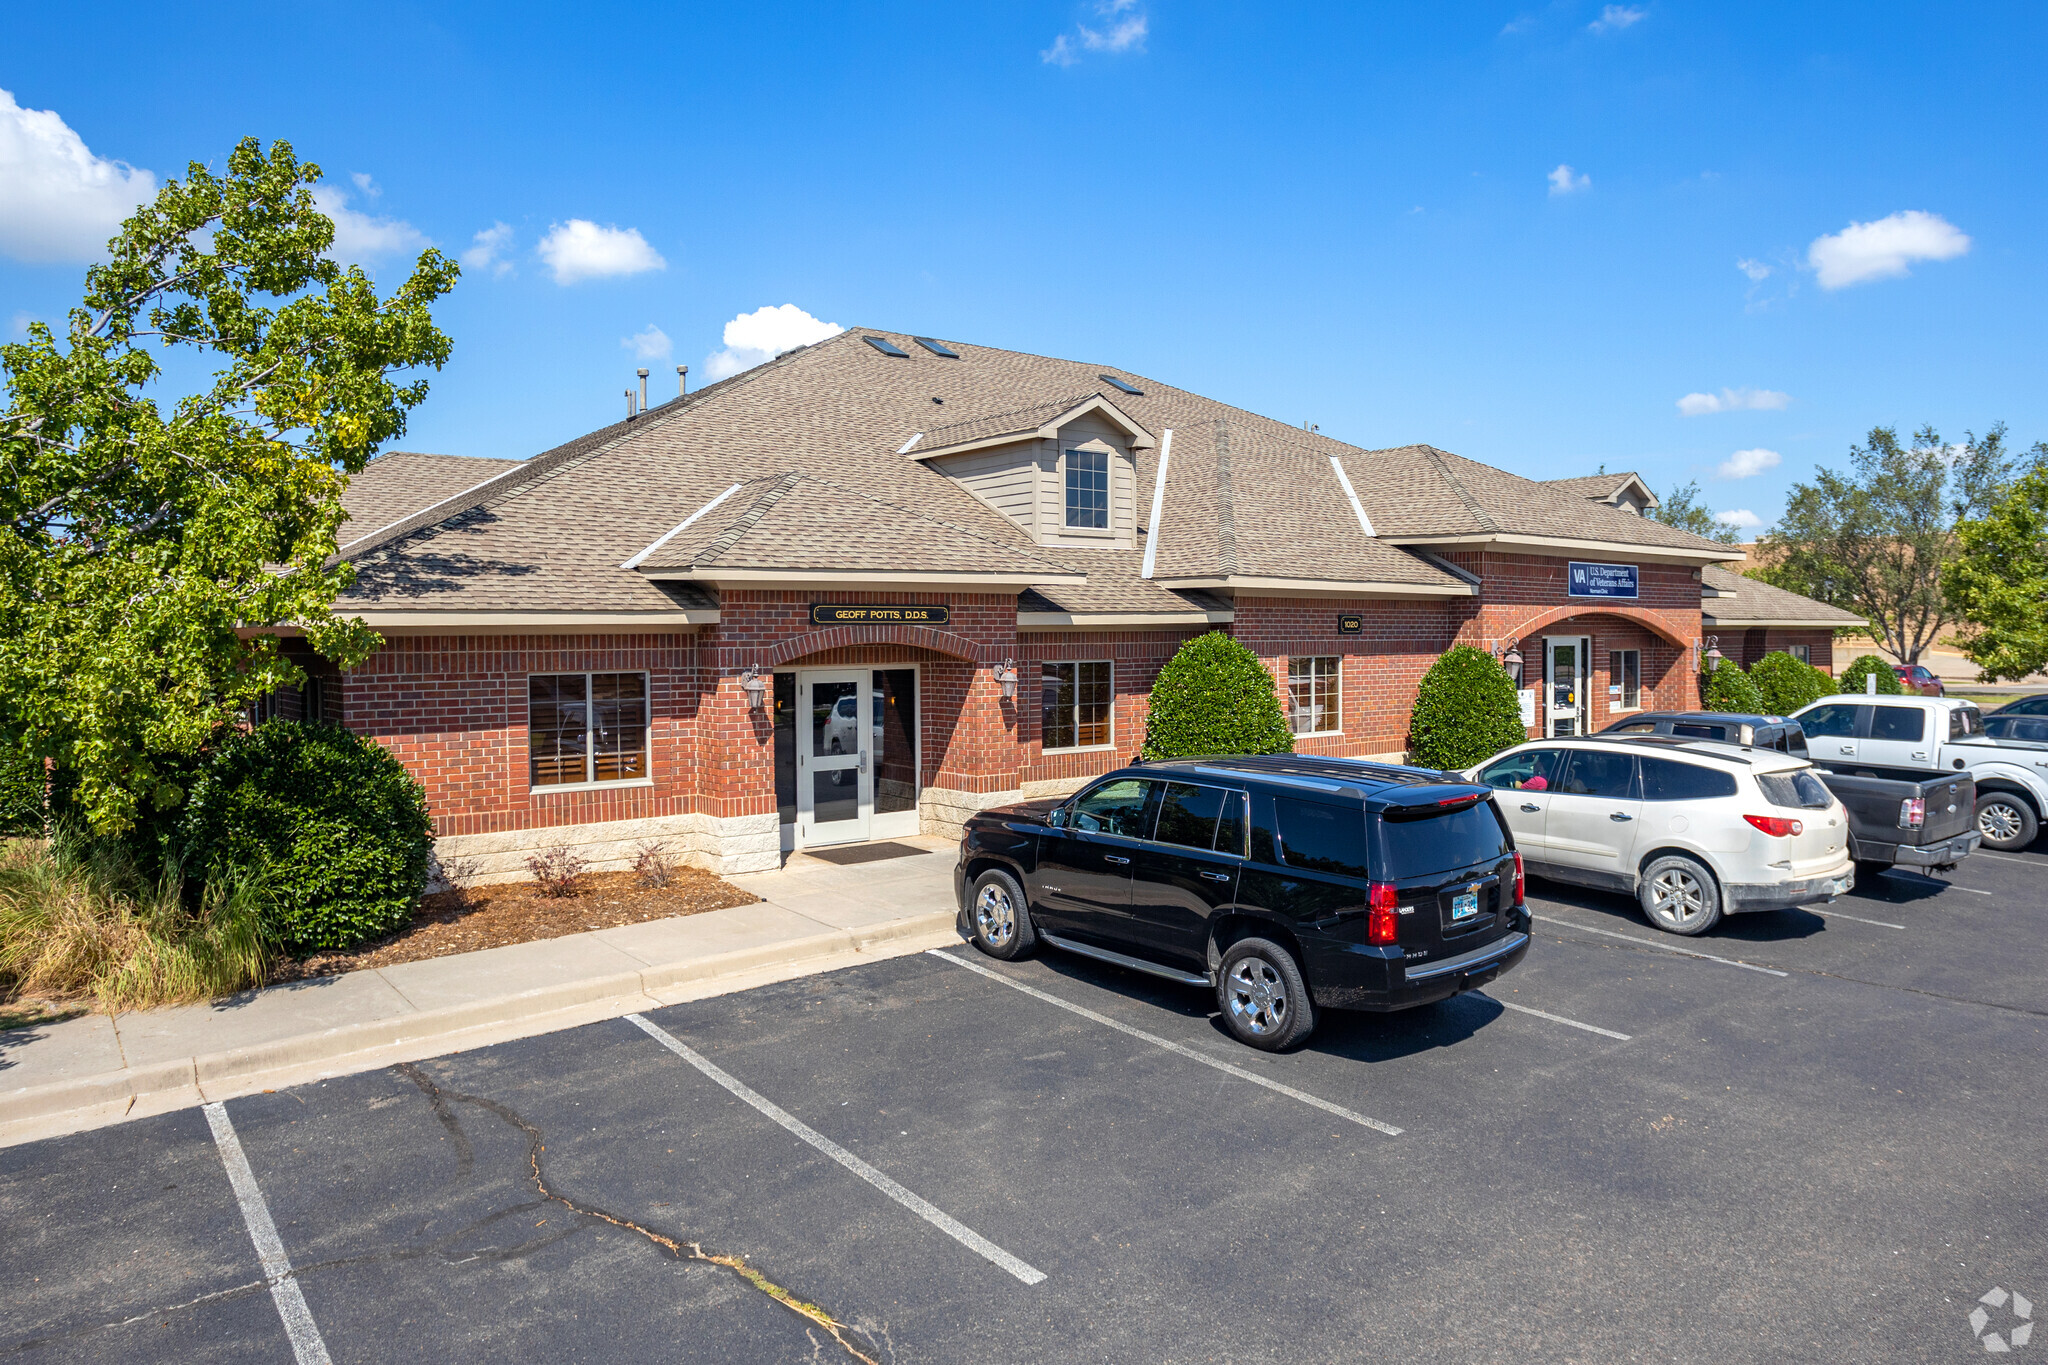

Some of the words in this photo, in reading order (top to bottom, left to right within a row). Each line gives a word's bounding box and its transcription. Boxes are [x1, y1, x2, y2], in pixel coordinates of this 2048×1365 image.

[1574, 569, 1586, 584] VA
[1590, 567, 1599, 576] U.S.
[1600, 567, 1629, 578] Department
[1590, 578, 1595, 586] of
[1595, 578, 1617, 587] Veterans
[1618, 579, 1634, 588] Affairs
[835, 610, 866, 619] GEOFF
[870, 611, 902, 620] POTTS,
[905, 611, 929, 619] D.D.S.
